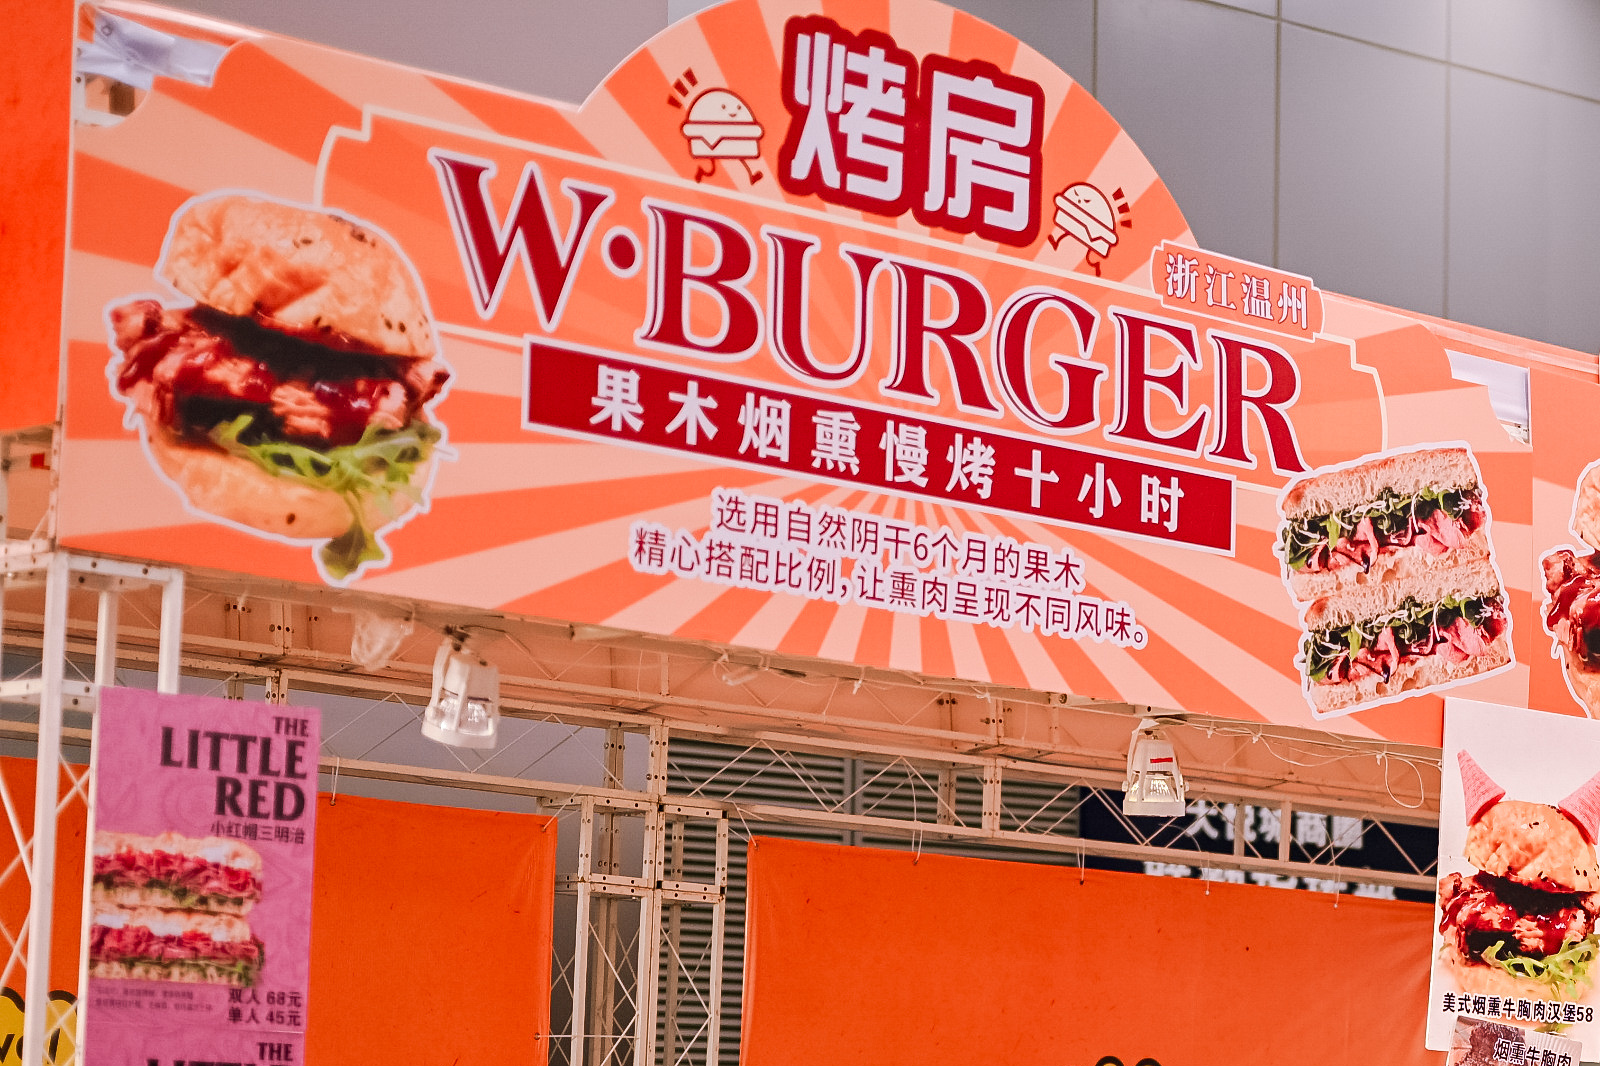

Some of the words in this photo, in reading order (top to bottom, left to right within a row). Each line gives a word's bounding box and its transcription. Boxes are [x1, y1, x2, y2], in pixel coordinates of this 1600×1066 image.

[786, 26, 1038, 238] 烤房
[1164, 252, 1310, 331] 浙江温州
[590, 364, 1187, 534] 果木烟熏慢烤十小时
[715, 493, 1084, 589] 选用自然阴干6个月的果木
[160, 726, 308, 780] LITTLE
[273, 716, 310, 738] THE
[213, 776, 306, 822] RED
[211, 821, 305, 845] 小红帽三明治
[257, 1041, 293, 1062] THE
